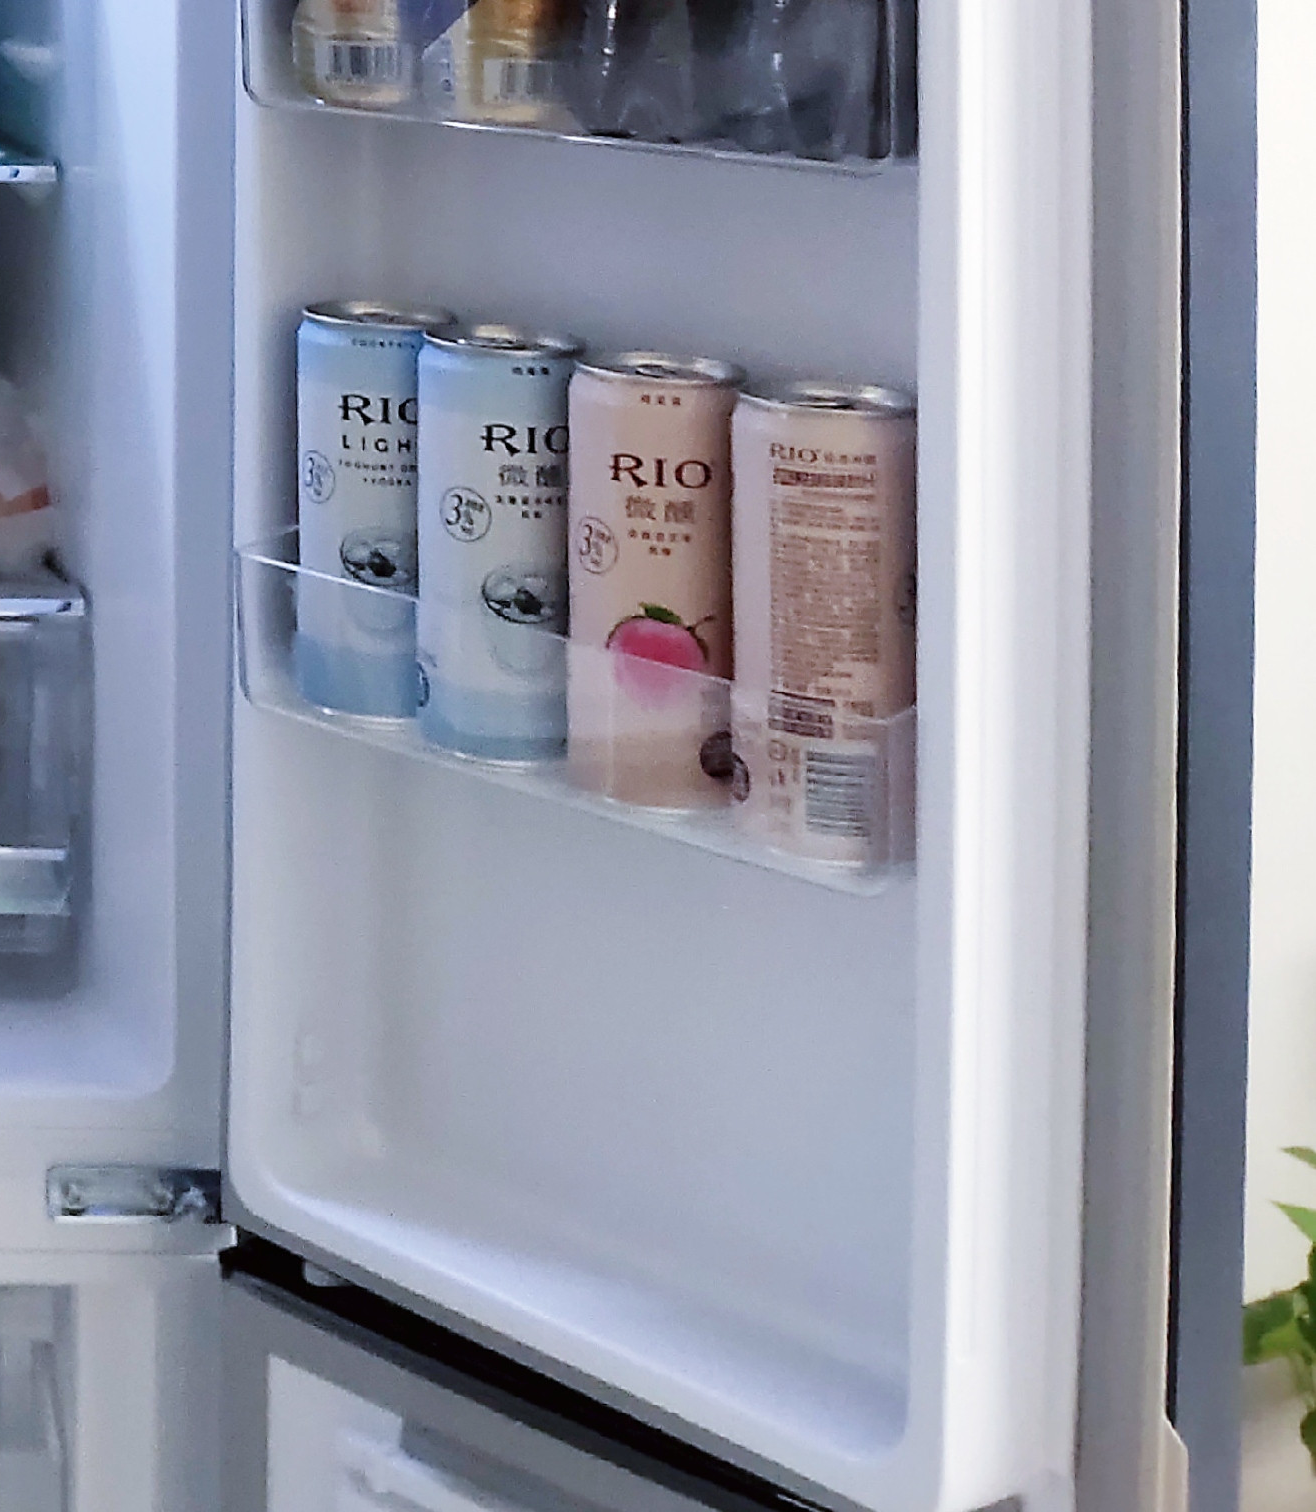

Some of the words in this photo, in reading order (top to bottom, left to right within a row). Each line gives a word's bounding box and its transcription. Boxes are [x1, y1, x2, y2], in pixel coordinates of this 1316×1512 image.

[342, 435, 416, 453] LIGH
[771, 443, 818, 463] RIO
[608, 453, 713, 488] RIO
